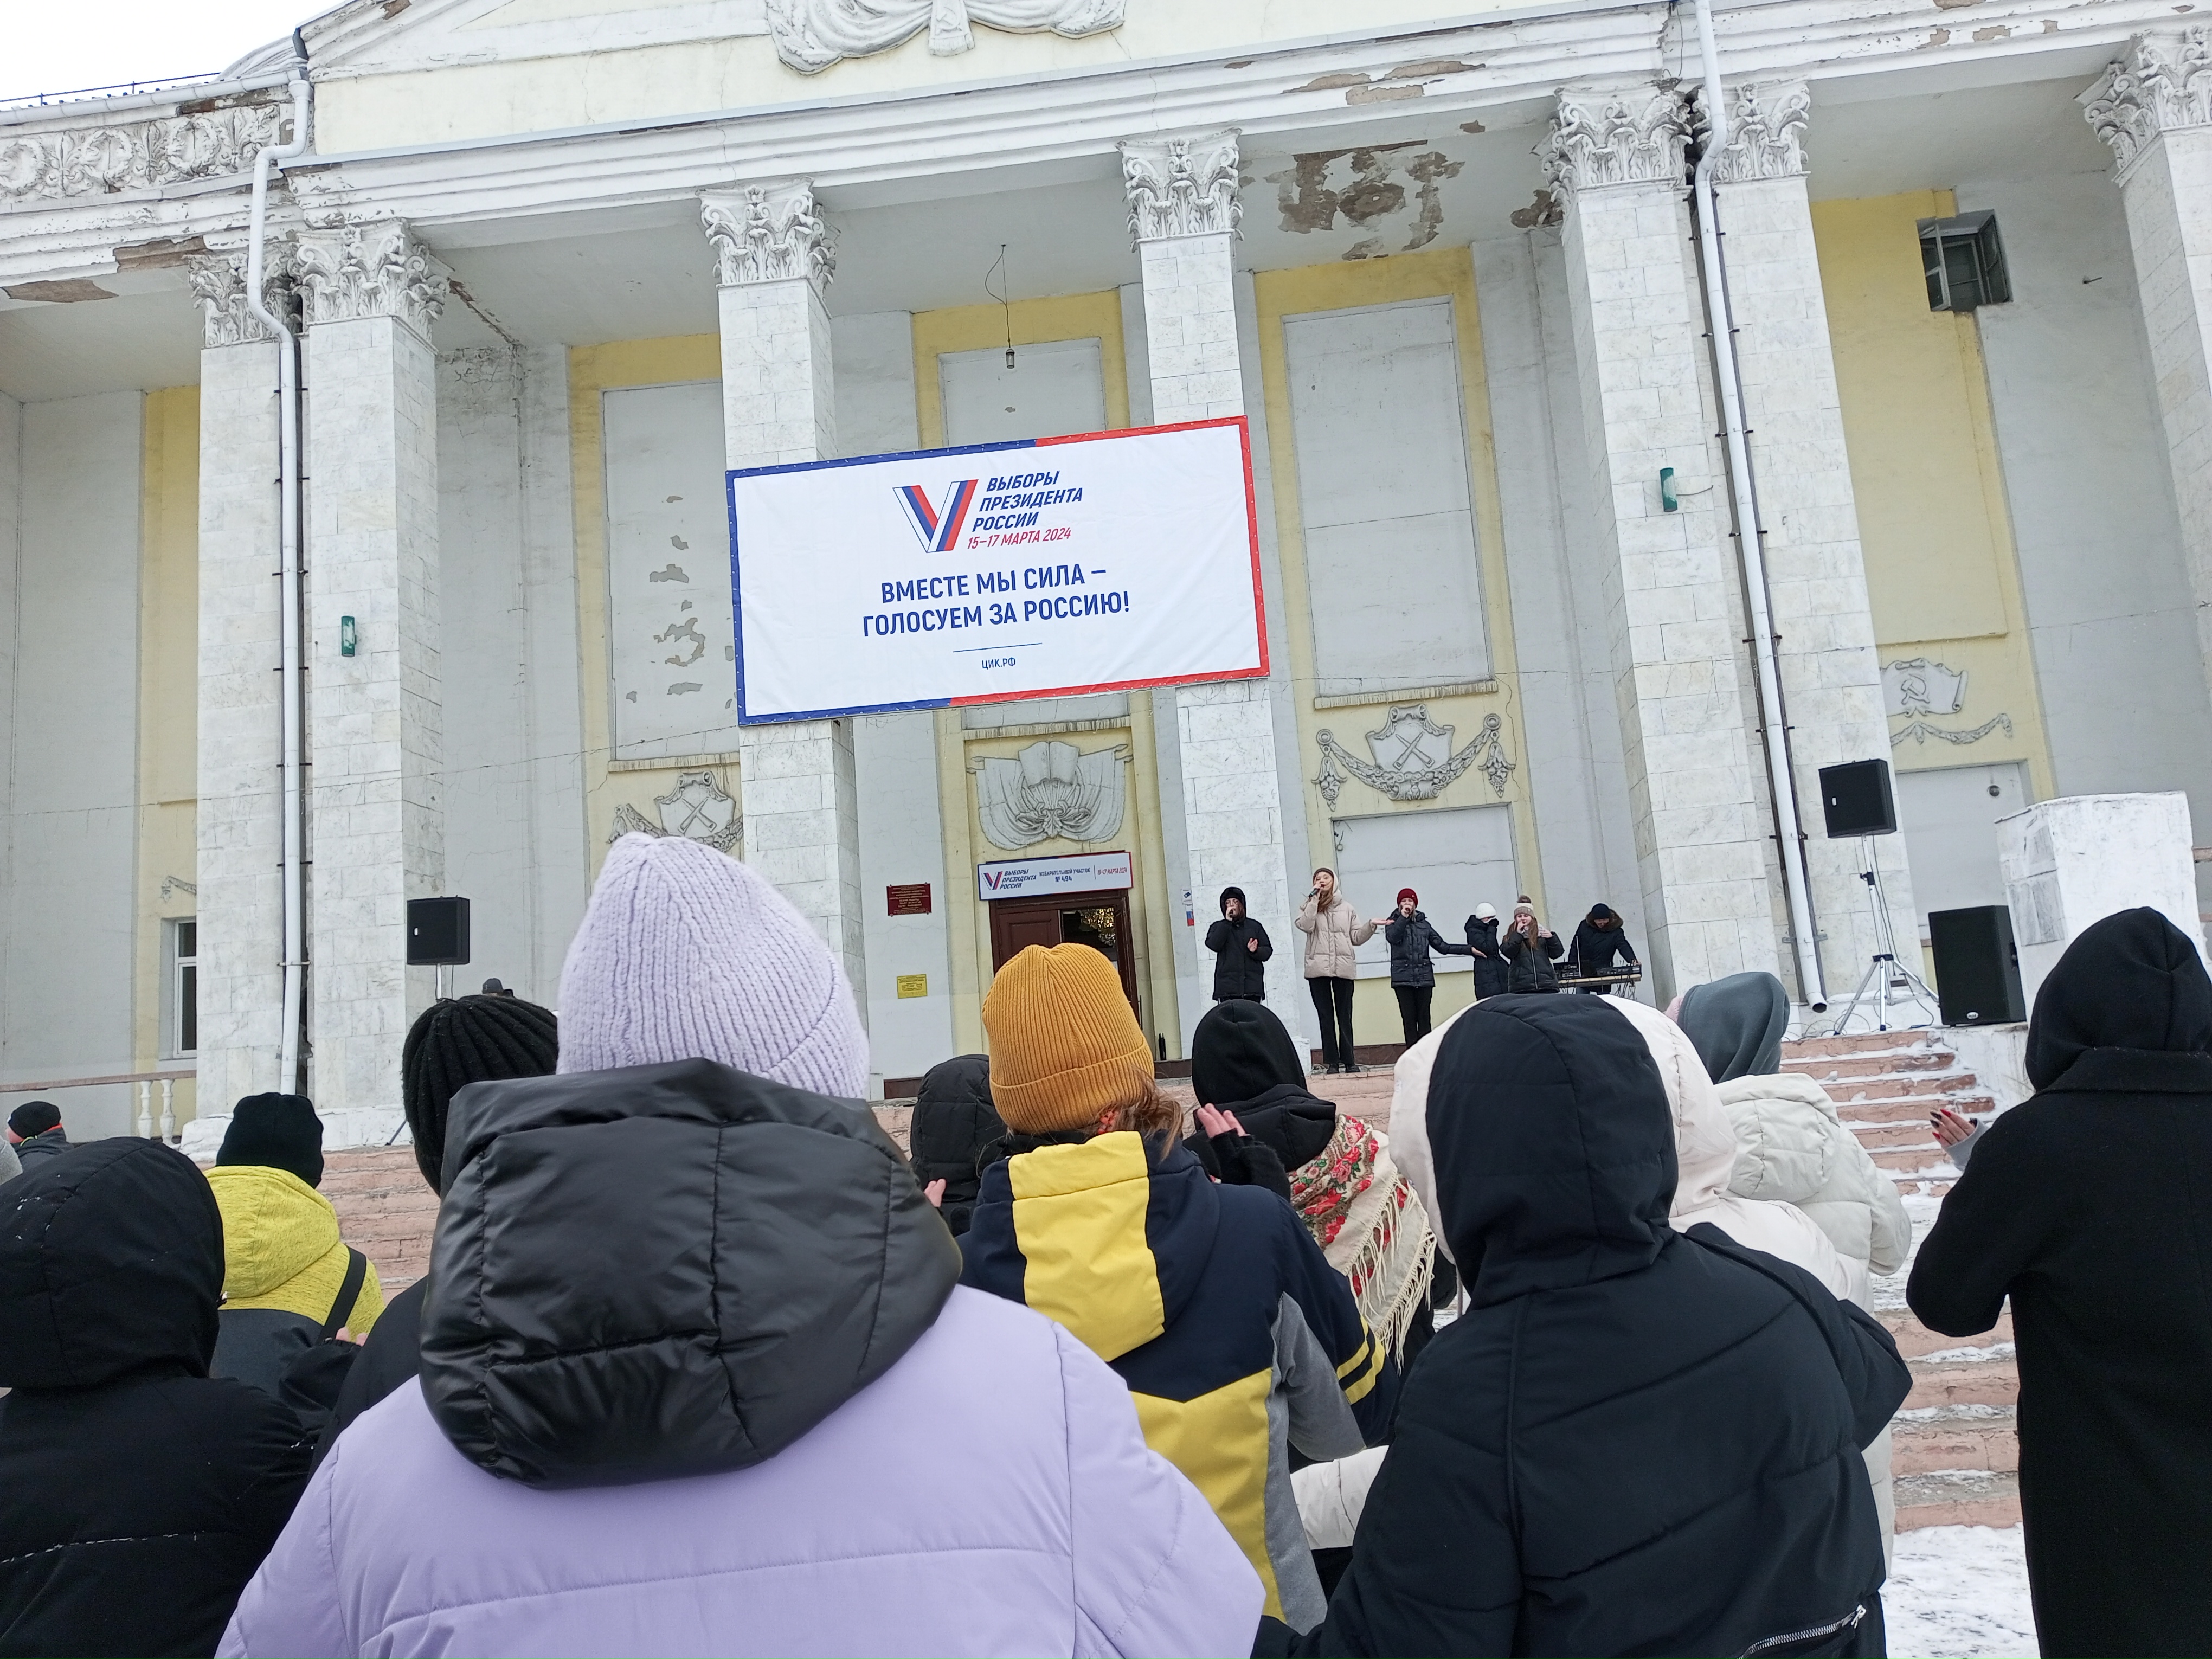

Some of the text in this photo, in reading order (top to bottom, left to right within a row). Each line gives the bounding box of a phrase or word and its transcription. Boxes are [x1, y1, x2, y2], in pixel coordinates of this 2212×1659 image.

[986, 470, 1060, 492] ВЫБОРЫ
[979, 487, 1083, 512] ПРЕЗИДЕНТА
[972, 511, 1039, 532] РОССИИ
[1000, 530, 1040, 546] МАРТА
[1043, 527, 1071, 541] 2024
[881, 575, 970, 603] ВМЕСТЕ
[976, 570, 1017, 594] МЫ
[1024, 564, 1085, 590] СИЛА
[863, 591, 1130, 637] ГОЛОСУЕМ ЗА РОССИЮ!
[981, 657, 1016, 670] ЦИК.РФ
[1002, 874, 1037, 883] ПРЕЗИДЕНТА
